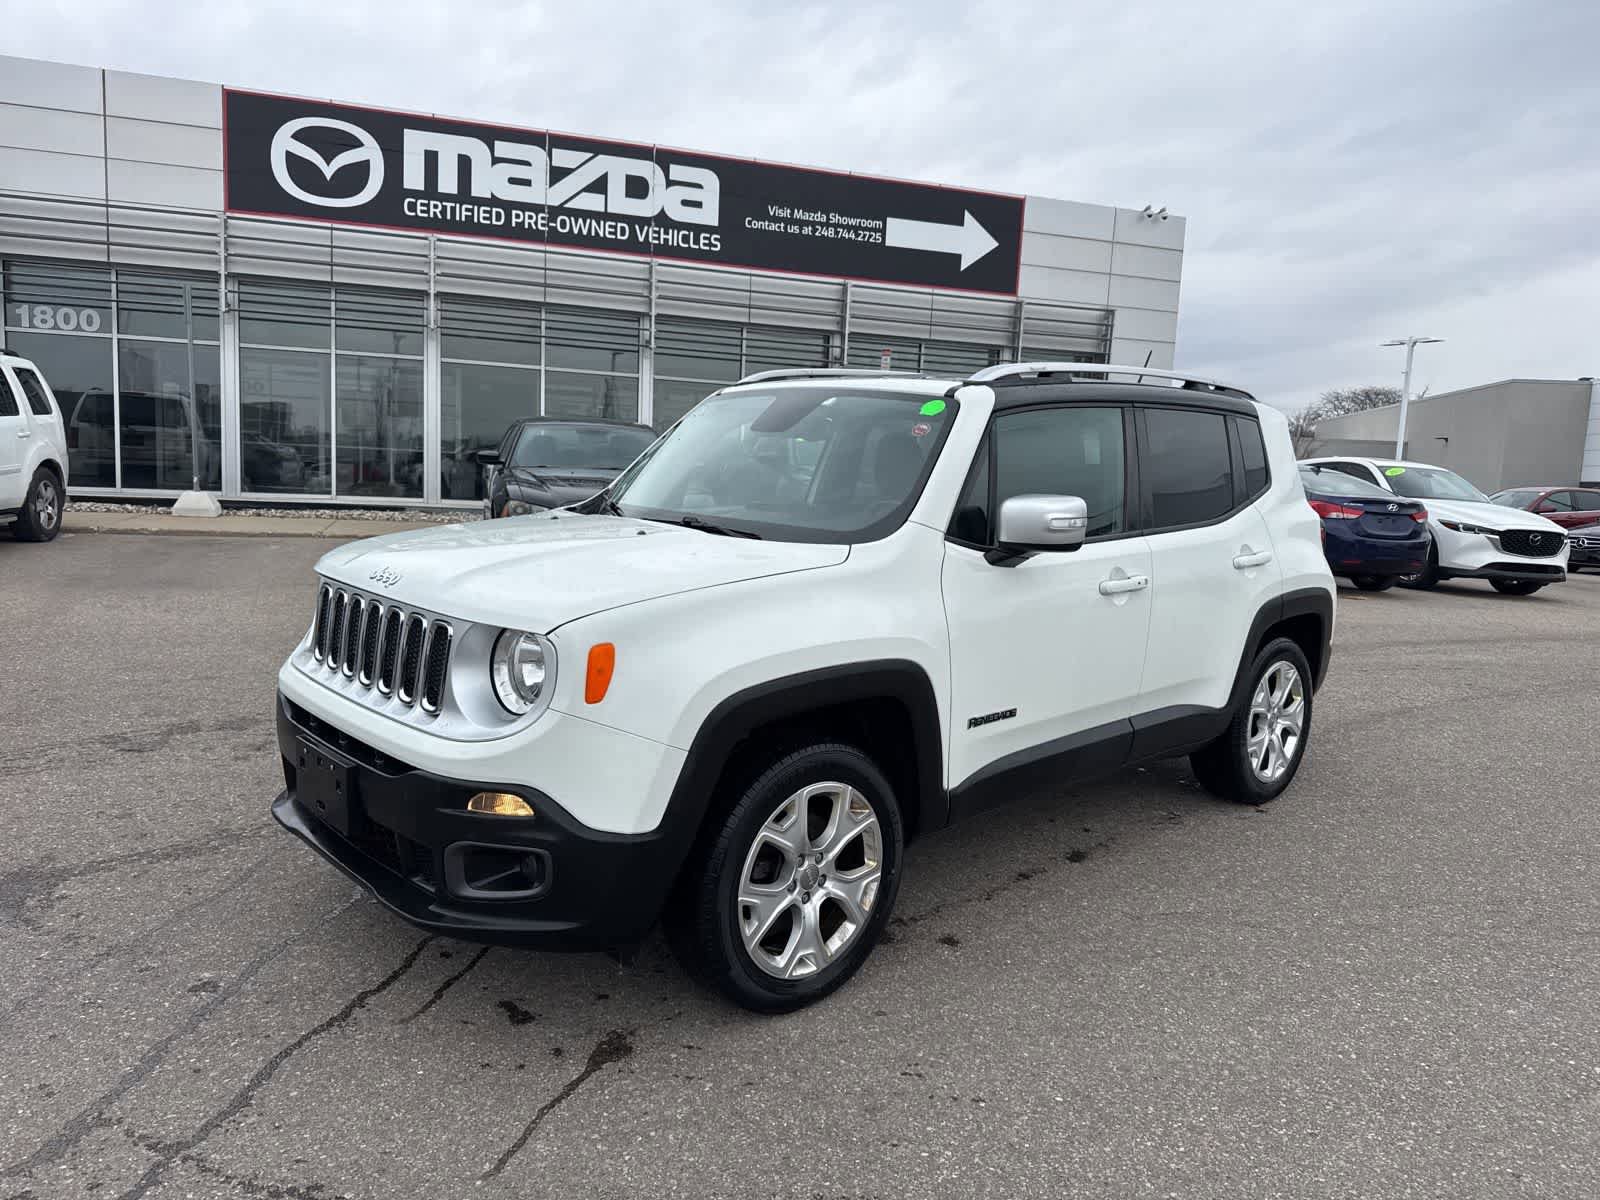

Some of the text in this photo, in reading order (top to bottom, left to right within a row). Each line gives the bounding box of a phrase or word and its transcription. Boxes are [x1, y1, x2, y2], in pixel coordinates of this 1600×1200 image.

[403, 198, 721, 251] CERTIFIED PRE-OWNED VEHICLES
[745, 217, 882, 243] Contact us at 248.744.2725
[768, 205, 883, 229] Visit Mazda Showroom
[15, 304, 101, 332] 1800
